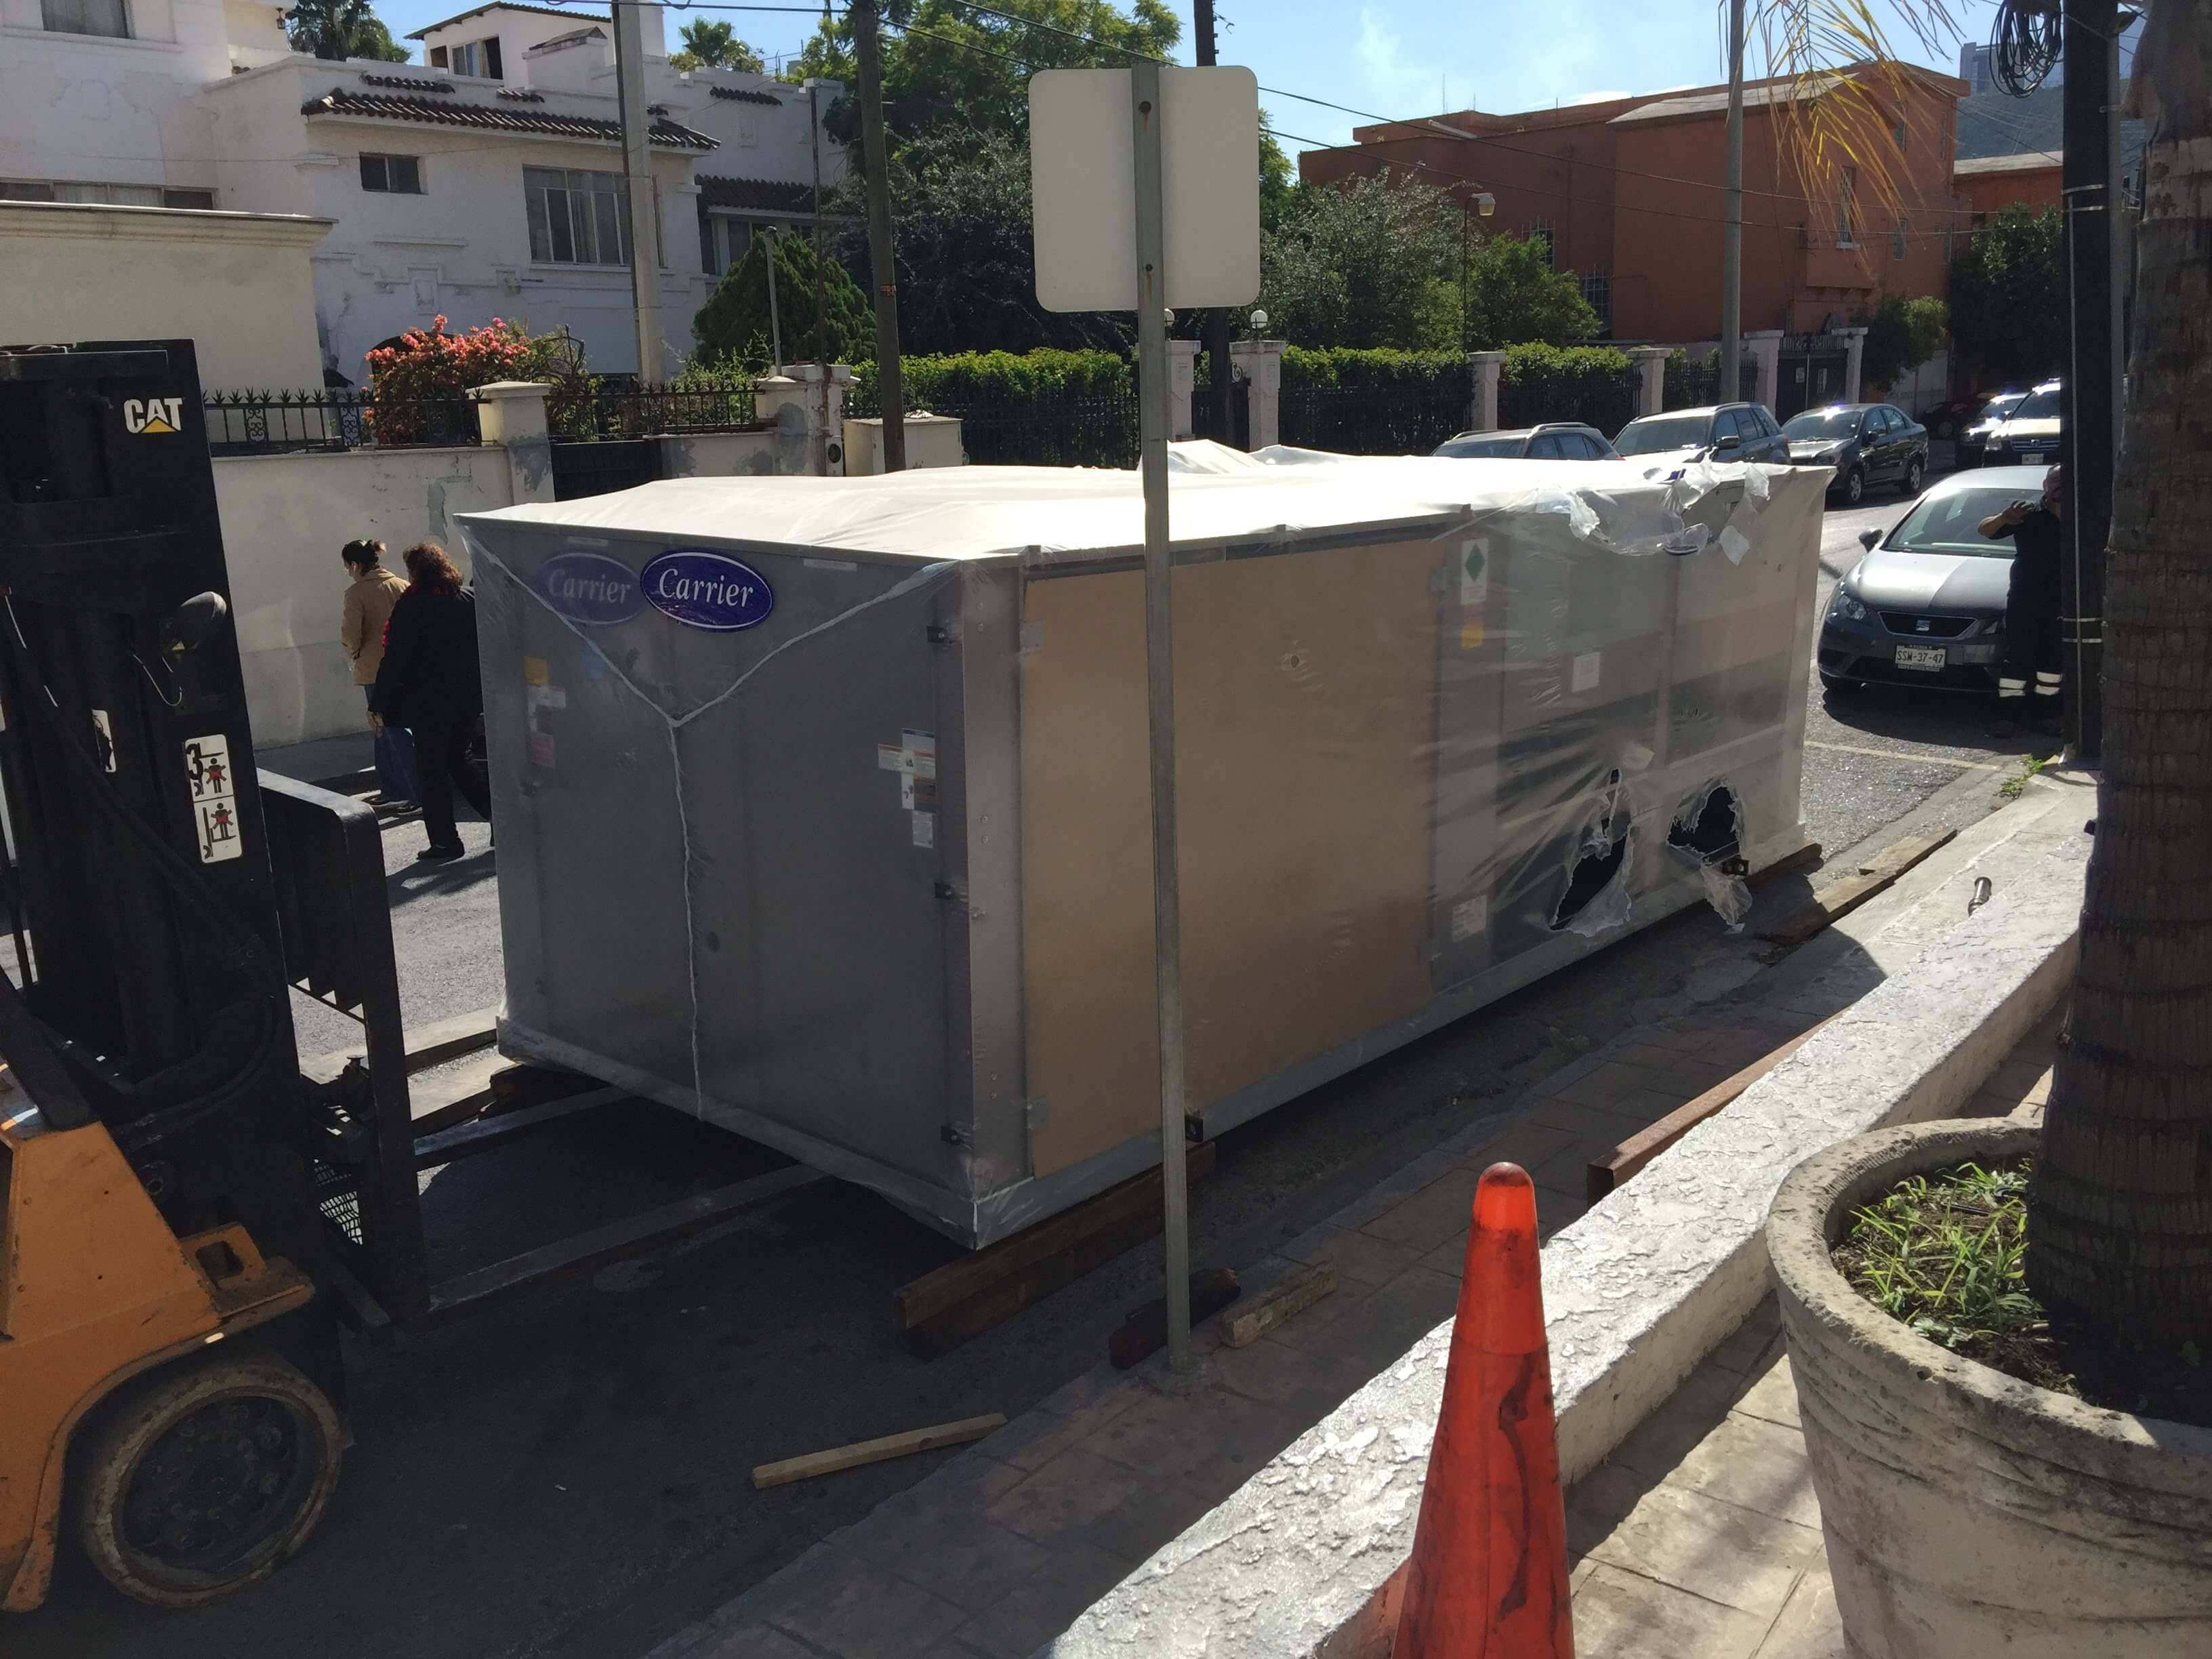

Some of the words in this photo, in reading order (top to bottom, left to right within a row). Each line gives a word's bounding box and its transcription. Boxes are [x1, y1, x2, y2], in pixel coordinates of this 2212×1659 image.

[123, 398, 183, 434] CAT
[548, 569, 631, 603] Carrier
[659, 568, 754, 608] Carrier
